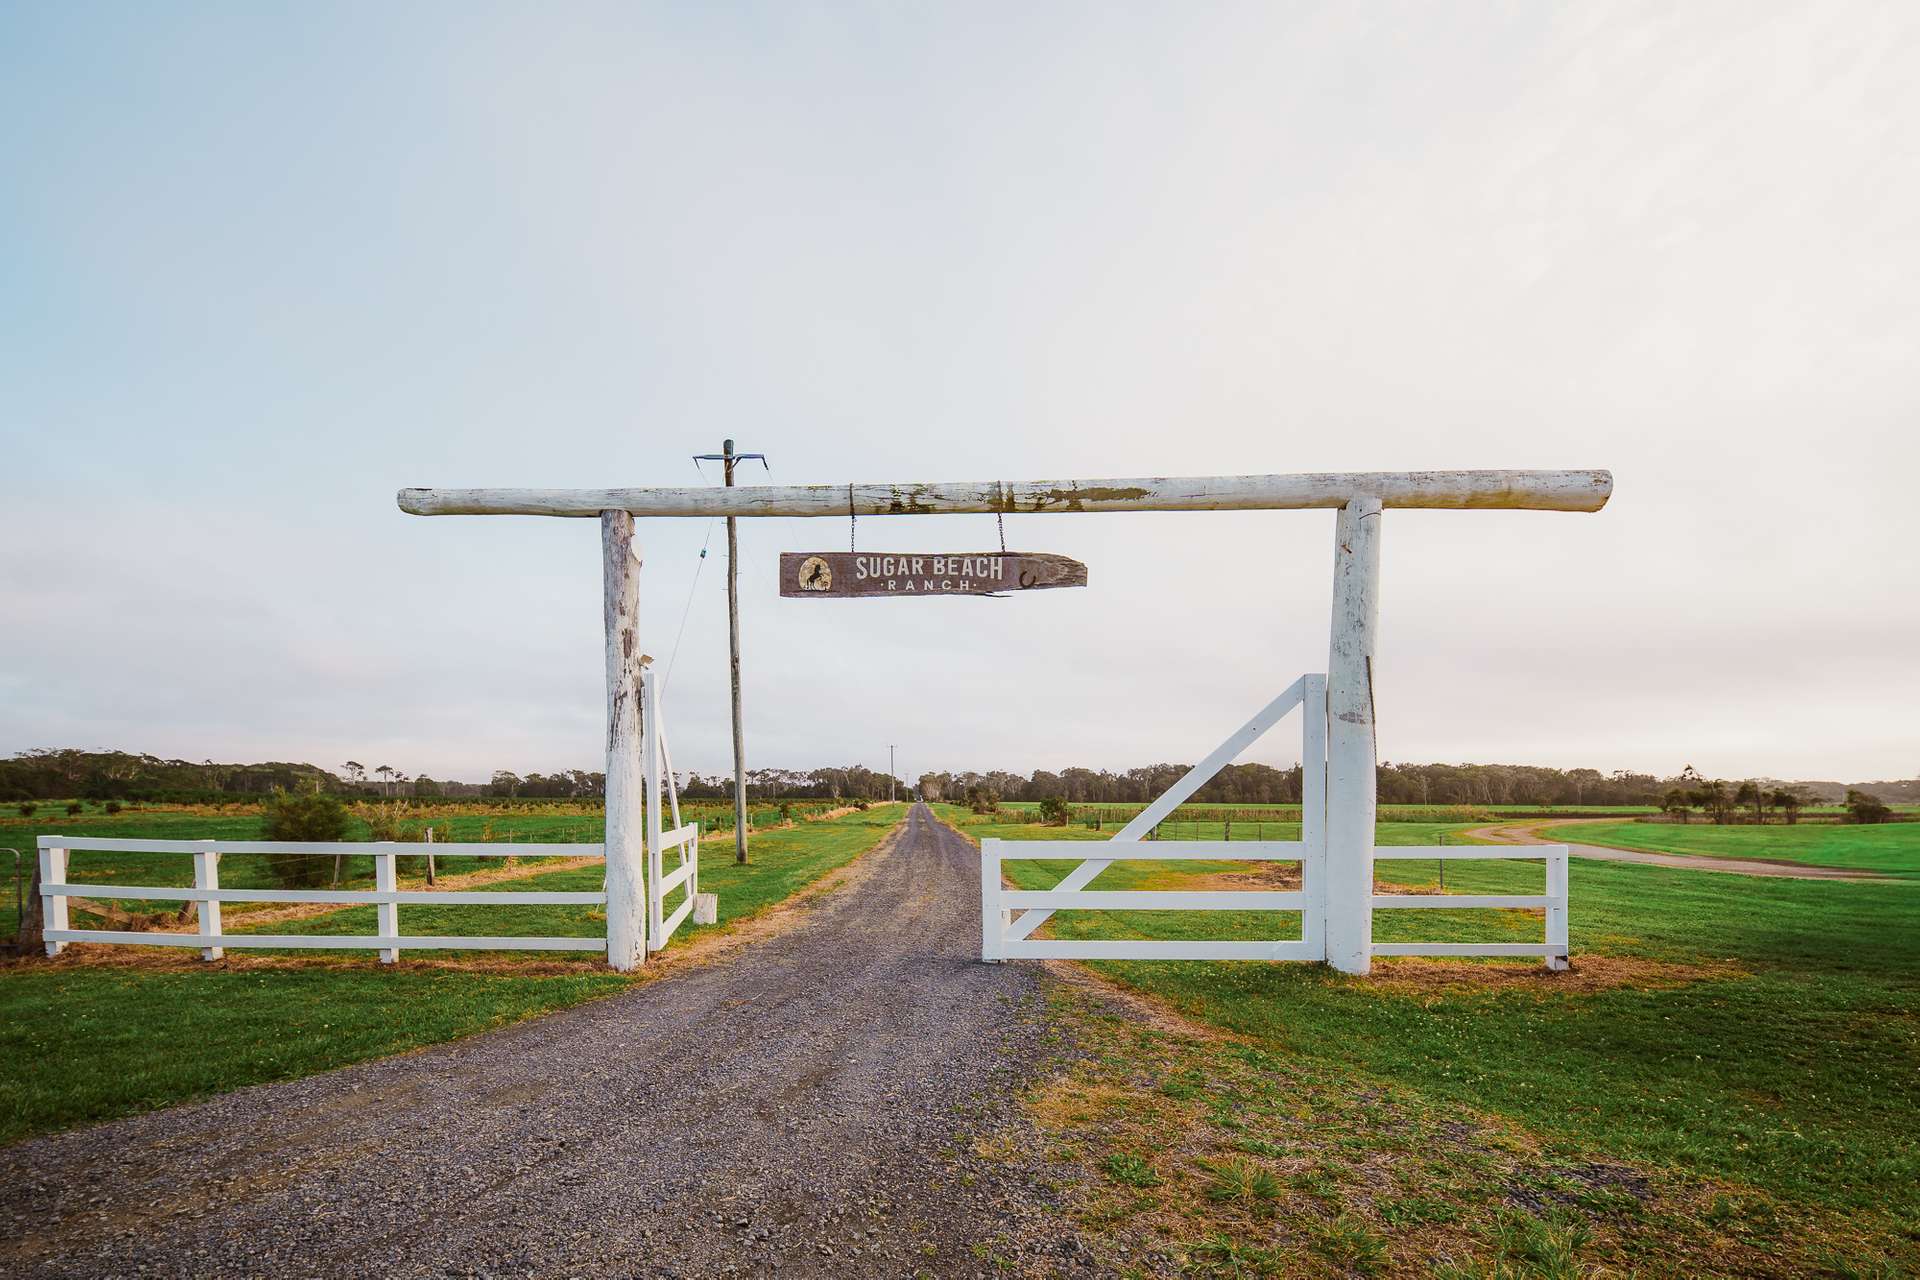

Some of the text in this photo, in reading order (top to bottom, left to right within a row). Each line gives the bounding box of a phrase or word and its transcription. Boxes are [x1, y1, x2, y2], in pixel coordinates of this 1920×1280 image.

[856, 556, 1003, 580] SUGAR BEACH
[888, 580, 971, 591] RANCH
